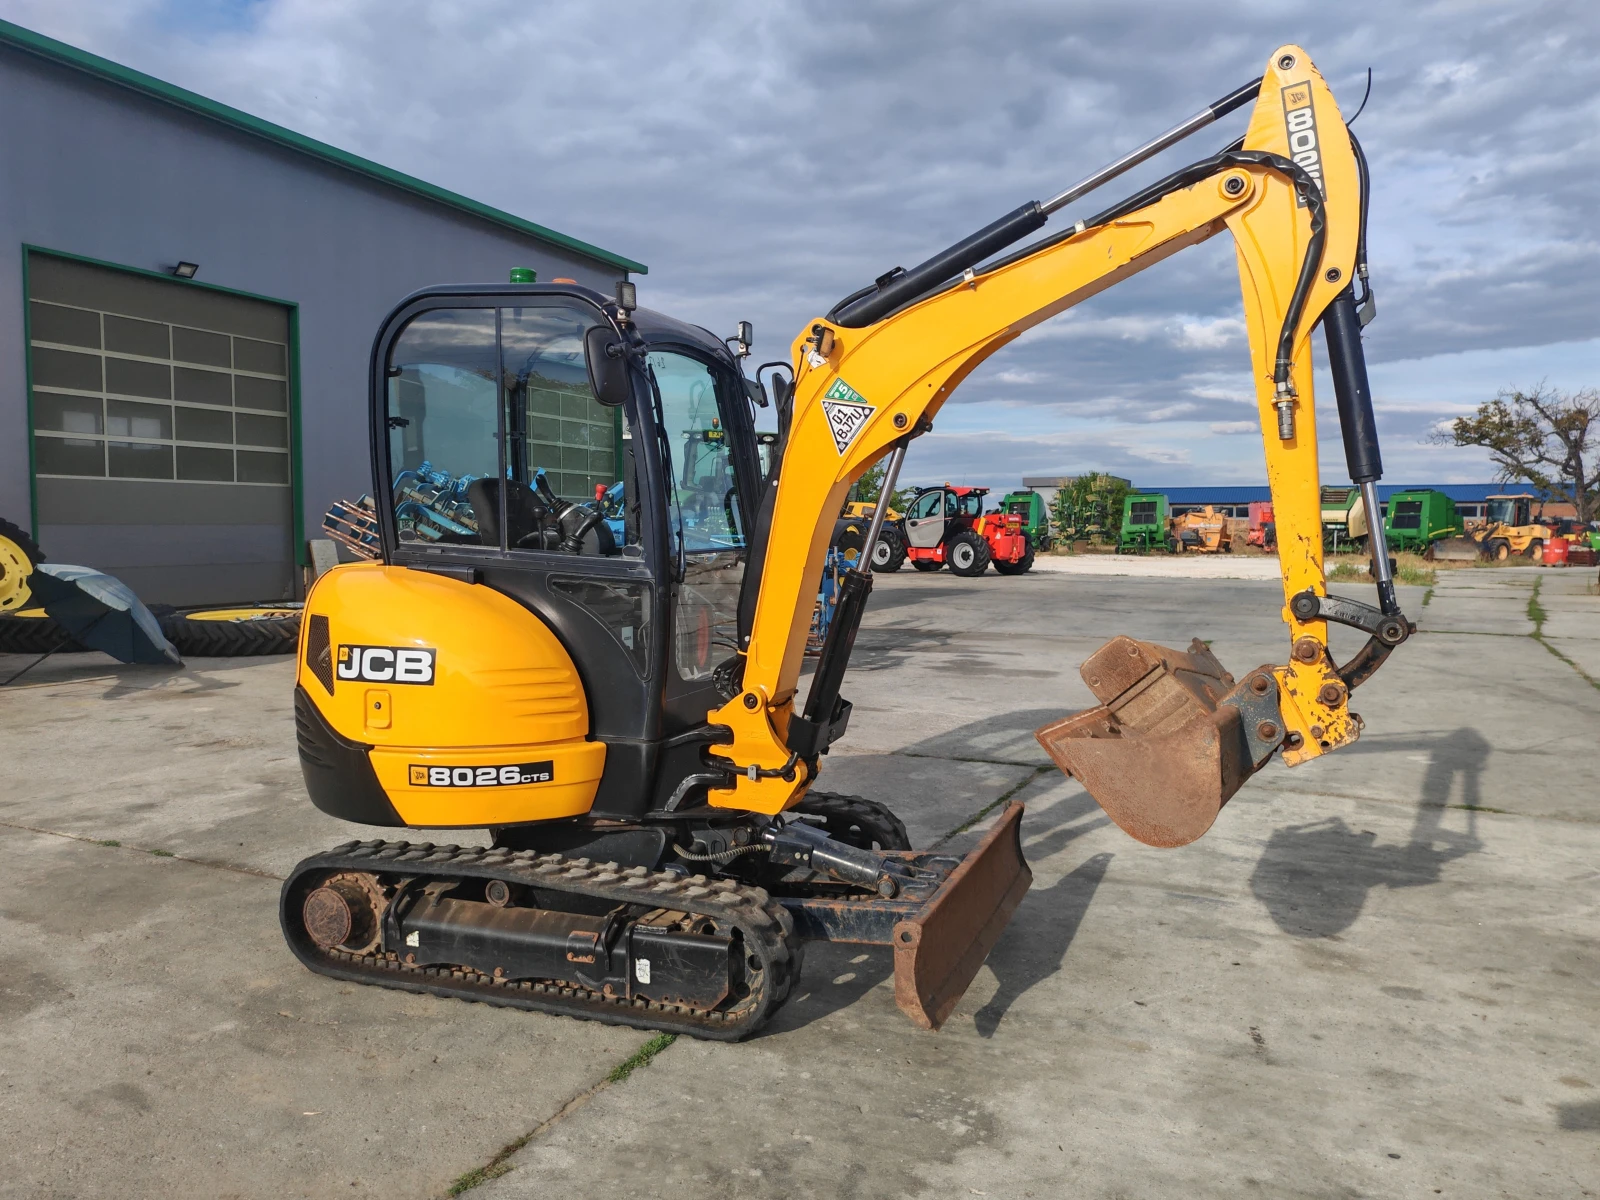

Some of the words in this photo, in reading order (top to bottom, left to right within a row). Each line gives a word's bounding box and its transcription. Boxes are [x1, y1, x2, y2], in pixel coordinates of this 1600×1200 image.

[838, 384, 849, 395] 5
[836, 408, 863, 440] BJ7U
[338, 647, 433, 683] JCB
